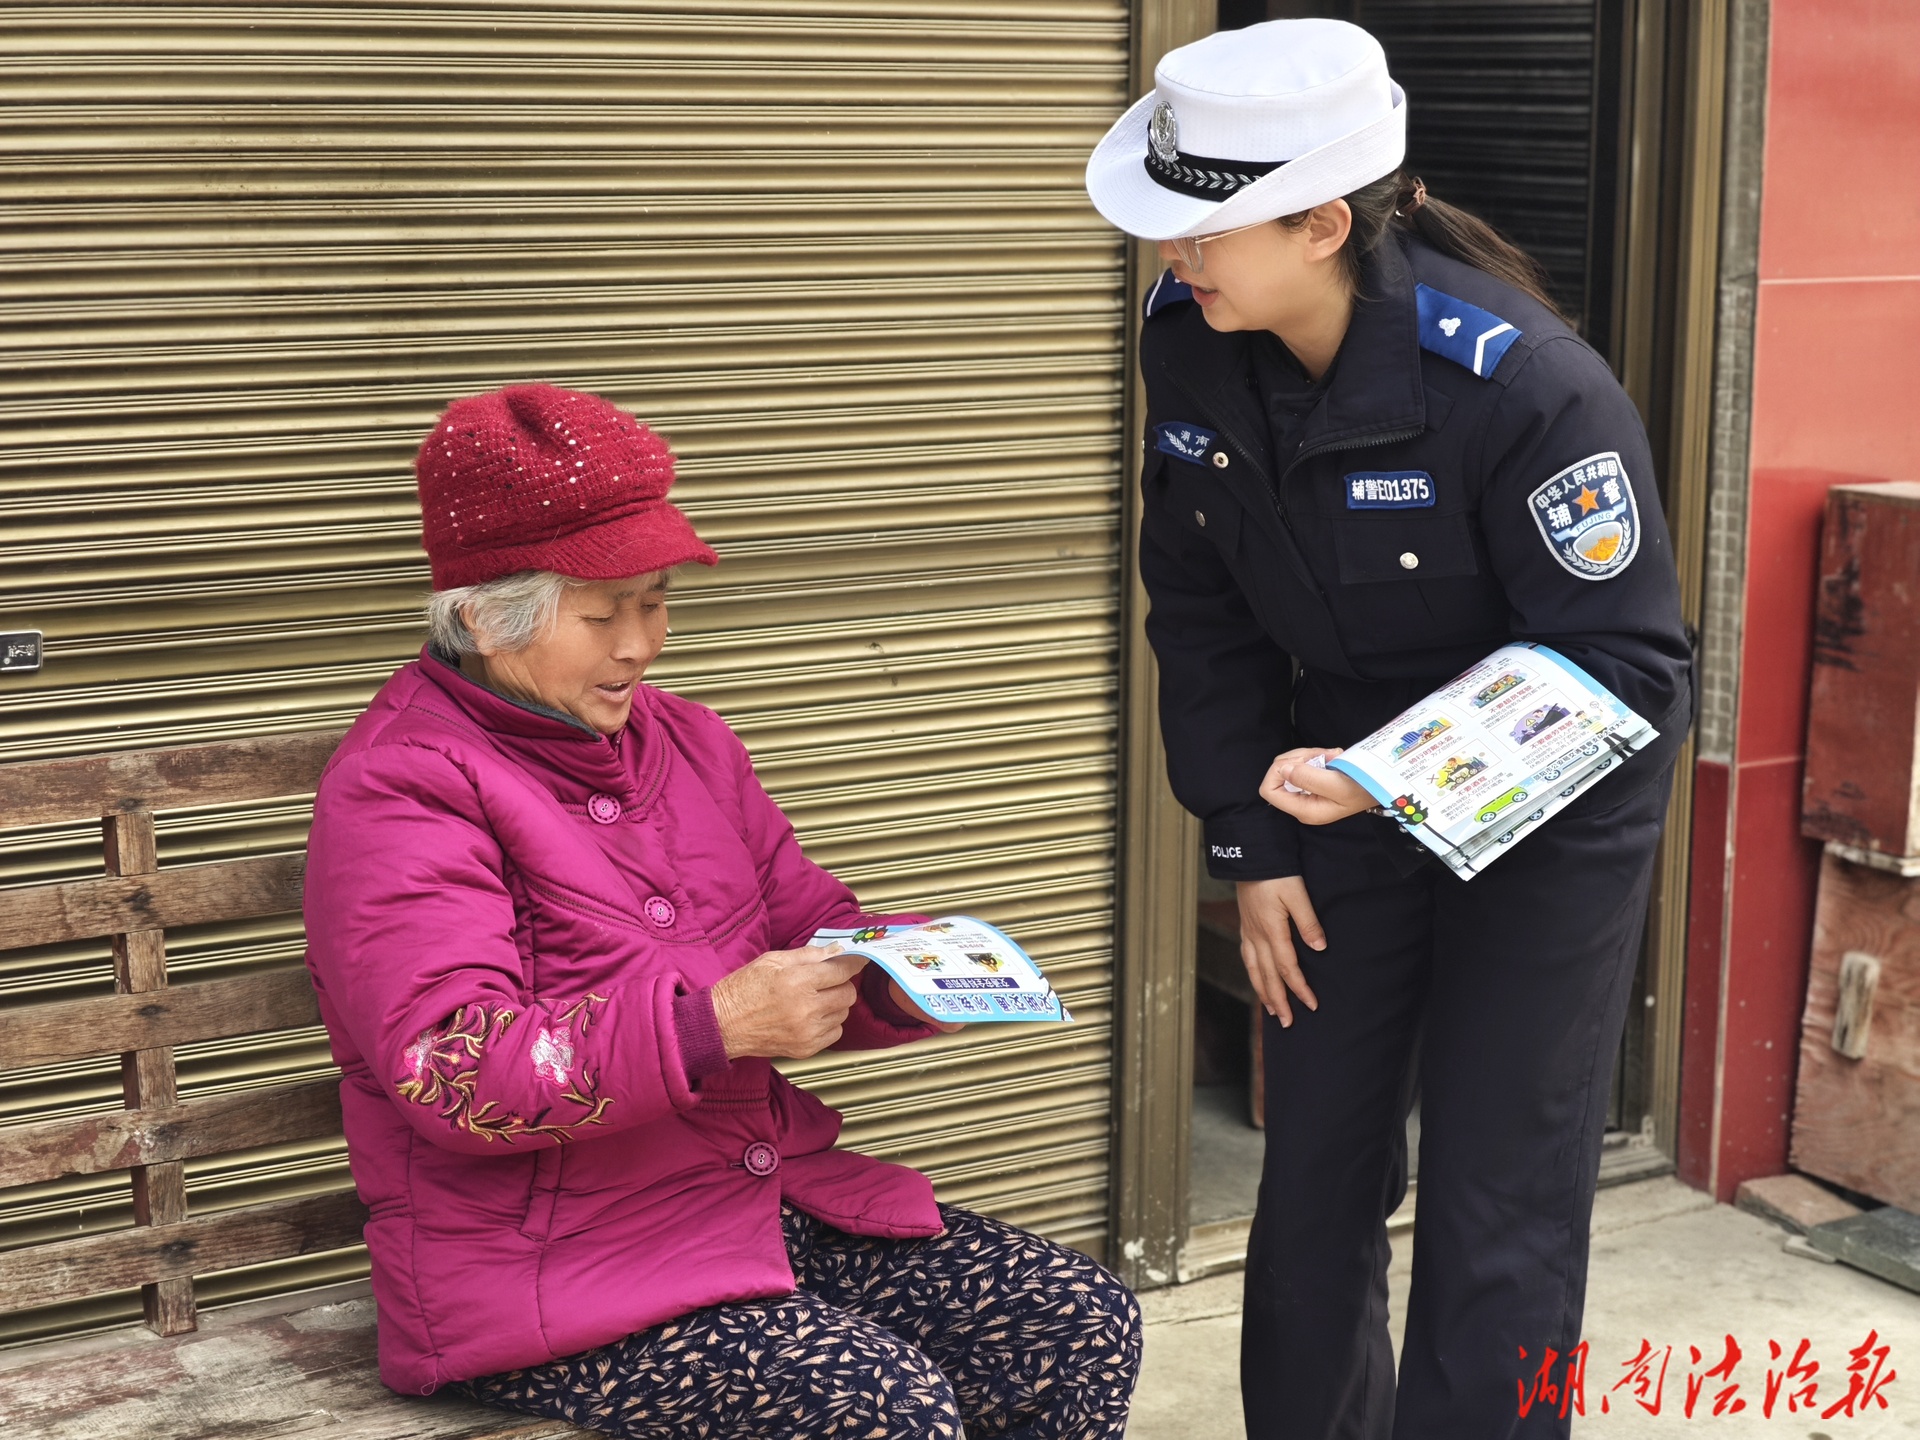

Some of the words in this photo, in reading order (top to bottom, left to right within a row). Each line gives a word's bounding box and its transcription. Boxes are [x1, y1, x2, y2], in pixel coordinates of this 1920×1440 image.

[1180, 430, 1210, 447] 湖南
[1535, 460, 1618, 510] 中华人民共和国
[1576, 512, 1612, 532] FUJING
[1212, 845, 1243, 859] POLICE
[941, 978, 1012, 989] 交通安全科普知识
